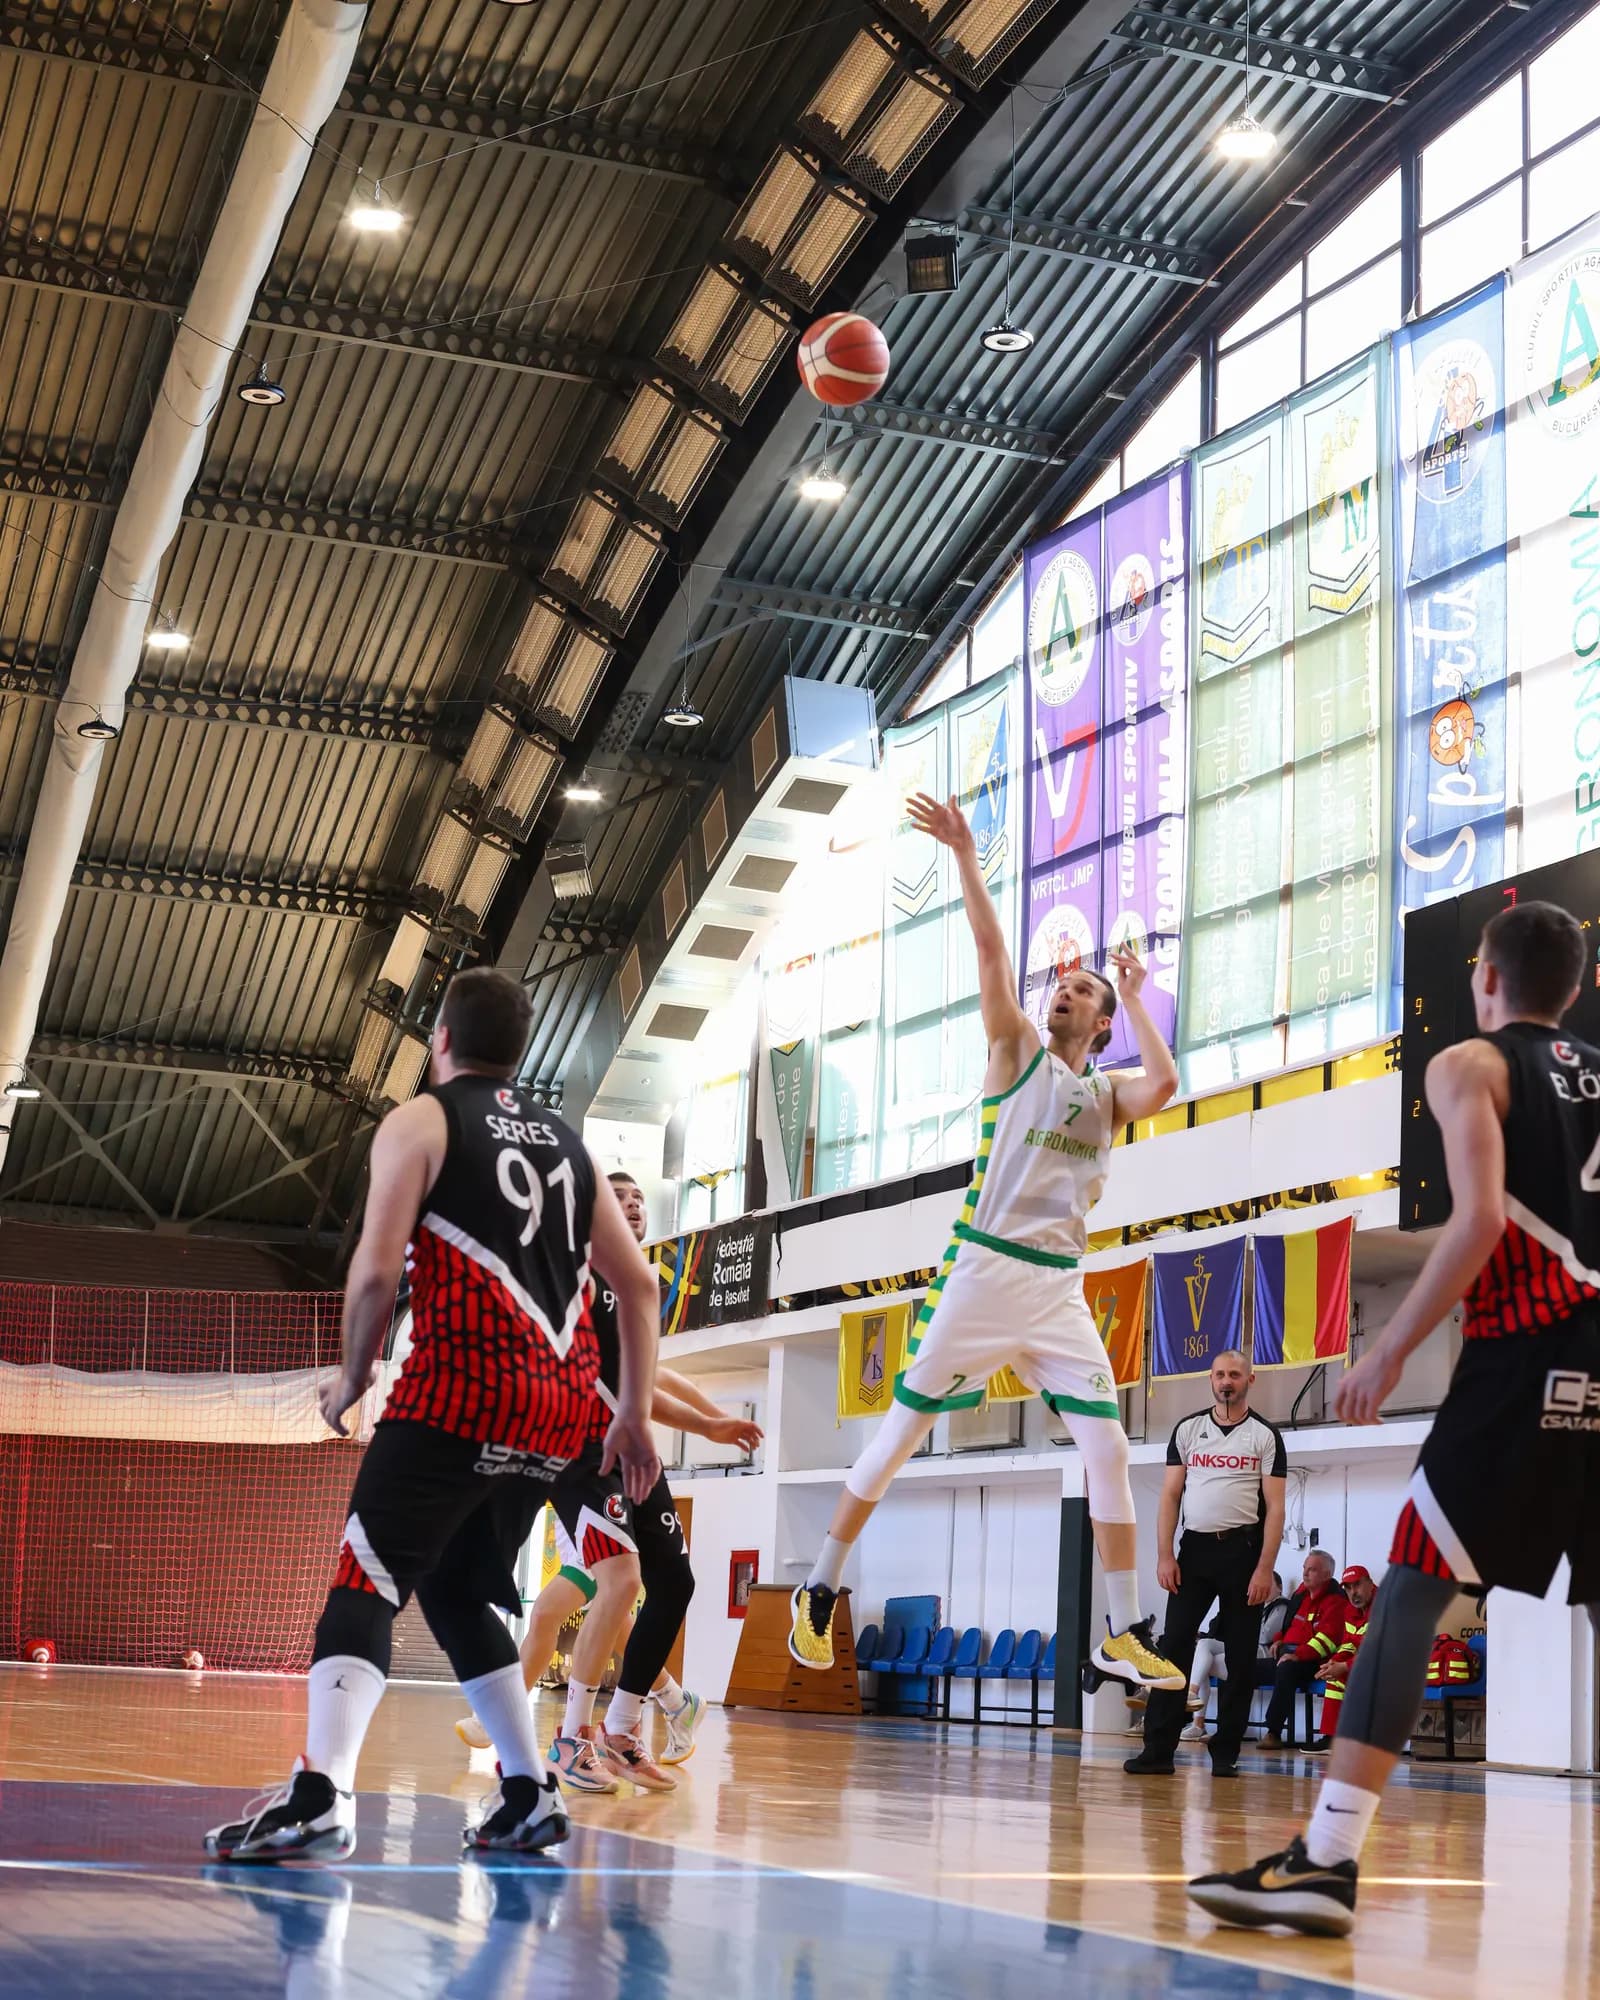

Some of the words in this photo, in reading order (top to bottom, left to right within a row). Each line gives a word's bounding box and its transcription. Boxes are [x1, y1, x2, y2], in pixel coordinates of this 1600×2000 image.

[1542, 262, 1581, 306] SPORTIV
[1423, 447, 1467, 472] SPORTS
[1123, 656, 1139, 784] SPORTIV
[1234, 663, 1253, 806] Mediului
[1312, 687, 1337, 905] Management
[1120, 791, 1138, 899] CLUBUL
[1031, 873, 1069, 901] VRTCL
[1070, 863, 1095, 890] JMP
[1153, 736, 1184, 997] AGRONOMIA
[1315, 913, 1332, 955] de
[776, 1072, 787, 1105] de
[485, 1114, 560, 1147] SERES
[1063, 1103, 1082, 1127] 7
[1024, 1127, 1098, 1162] AGRONOMIA
[495, 1147, 576, 1253] 91
[711, 1255, 752, 1285] Română
[709, 1289, 723, 1307] de
[1183, 1333, 1209, 1359] 1861
[945, 1374, 967, 1394] 7
